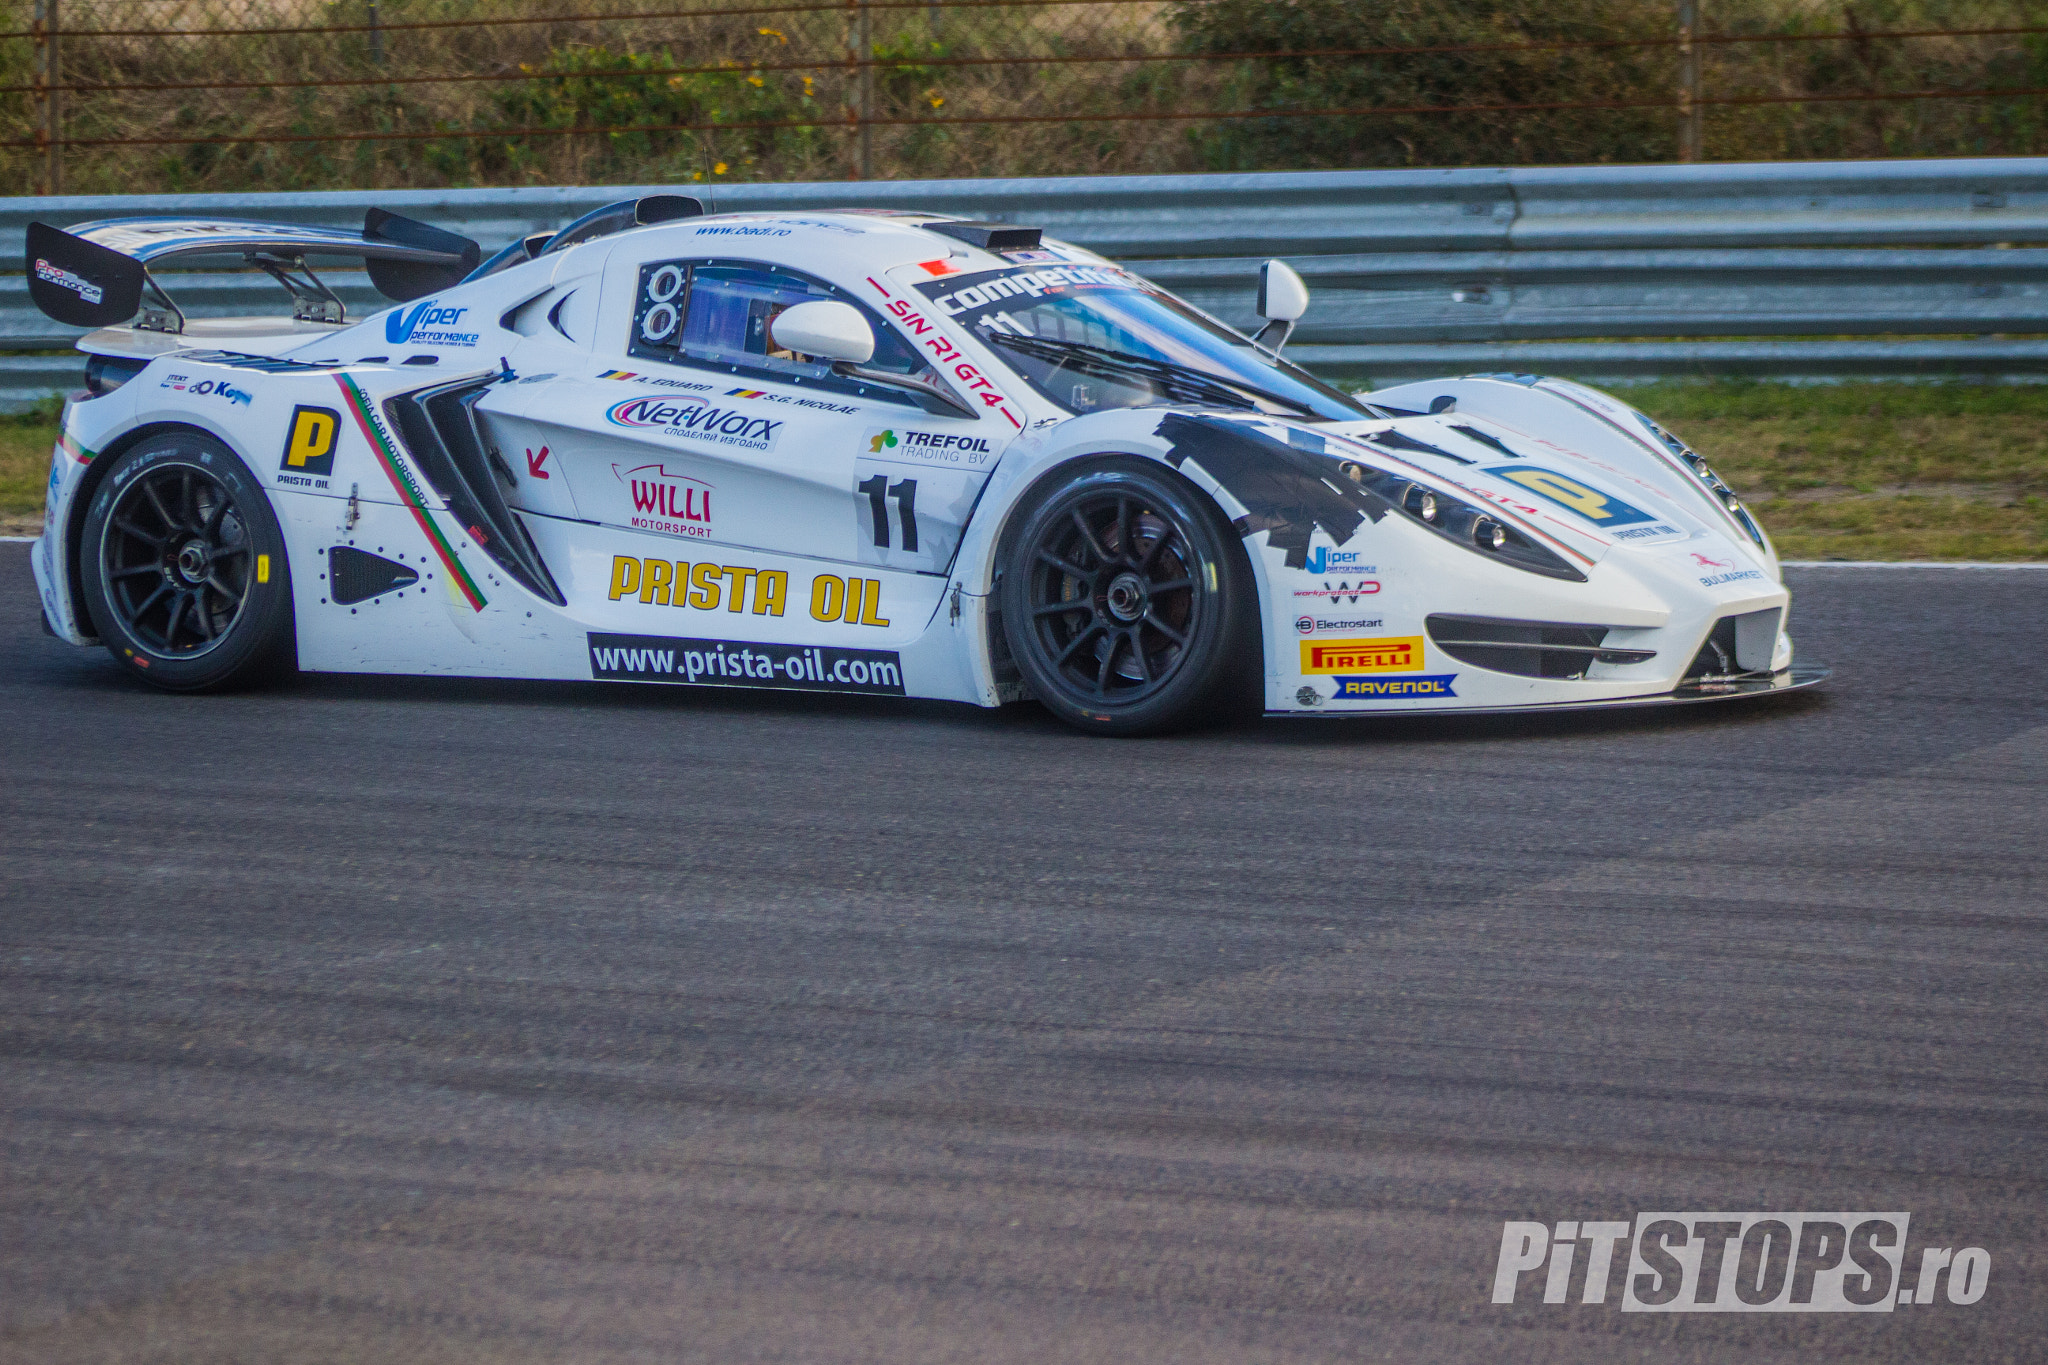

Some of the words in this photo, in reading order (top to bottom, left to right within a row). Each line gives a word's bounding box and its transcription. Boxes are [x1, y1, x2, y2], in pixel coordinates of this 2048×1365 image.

[695, 226, 792, 237] www.badi.ro
[36, 260, 64, 278] Pro
[386, 299, 469, 345] Viper
[977, 310, 1035, 337] 11
[885, 299, 934, 336] SIN
[925, 336, 962, 363] R1
[954, 363, 1005, 407] GT4
[651, 378, 714, 392] EDUARD
[794, 399, 861, 415] NICOLAE
[286, 411, 334, 467] P
[664, 427, 717, 442] СПОДЕЛЯЙ
[719, 436, 768, 451] ИЗГОДНО
[905, 431, 990, 453] TREFOIL
[371, 413, 387, 437] CAR
[384, 435, 430, 508] MOTORSPORT
[901, 445, 960, 462] TRADING
[968, 453, 988, 465] BV
[277, 474, 312, 487] PRISTA
[314, 479, 330, 490] OIL
[631, 479, 711, 523] WILLI
[858, 474, 918, 553] 11
[631, 517, 712, 538] MOTORSPORT
[608, 555, 789, 617] PRISTA
[809, 573, 891, 628] OIL
[1316, 619, 1383, 630] Electrostart
[592, 643, 901, 687] www.prista-oil.com
[1311, 643, 1411, 669] PIRELLI
[1345, 680, 1446, 695] RAVENOL
